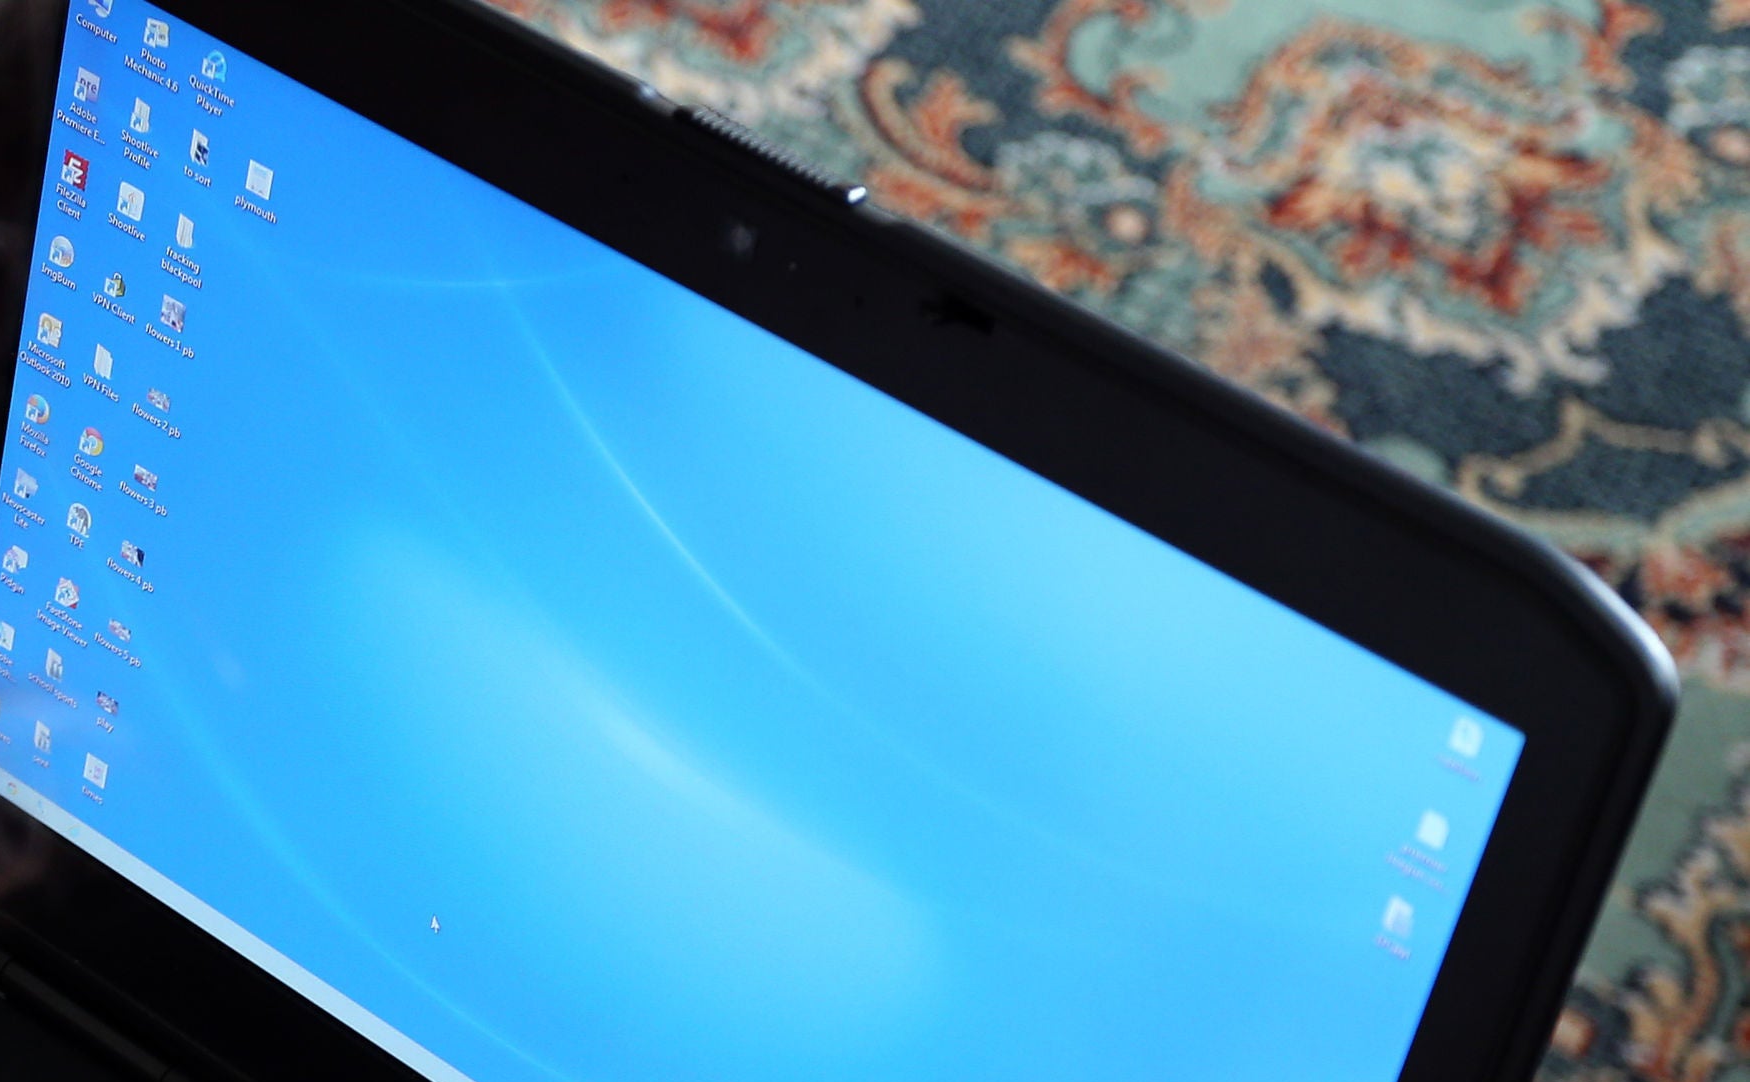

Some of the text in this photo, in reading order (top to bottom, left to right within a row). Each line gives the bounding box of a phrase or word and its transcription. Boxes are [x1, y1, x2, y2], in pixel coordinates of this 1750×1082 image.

[76, 13, 118, 44] Computer
[141, 48, 166, 70] Photo
[124, 55, 179, 93] Mechanic 4.6
[189, 74, 236, 108] QuickTime
[69, 101, 97, 124] Adobe
[196, 95, 223, 117] Player
[57, 110, 92, 138] Premiere
[121, 129, 159, 159] Shootlive
[123, 147, 150, 170] Profile
[184, 165, 212, 187] to sort
[55, 183, 87, 209] FileZilla
[57, 199, 81, 221] Client
[234, 195, 277, 225] plymouth
[108, 214, 146, 242] Shootlive
[161, 259, 201, 289] blackpool
[165, 246, 200, 275] fracking
[41, 263, 76, 290] ImgBurn
[93, 292, 135, 325] VPN Client
[145, 323, 175, 347] flowers
[182, 345, 195, 359] pb
[19, 351, 71, 388] Outlook 2010
[27, 341, 66, 370] Microsoft
[83, 372, 120, 402] VPN Files
[21, 422, 49, 445] Mozilla
[132, 403, 181, 439] flowers 2 pb
[19, 435, 47, 458] Firefox
[70, 466, 103, 491] Chrome
[74, 454, 103, 477] Google
[119, 481, 148, 506] flowers
[155, 502, 168, 517] pb
[69, 534, 85, 549] TPE
[107, 557, 135, 583] flowers
[142, 581, 154, 594] pb
[94, 632, 122, 657] flowers
[129, 655, 141, 668] pb
[97, 717, 114, 733] play
